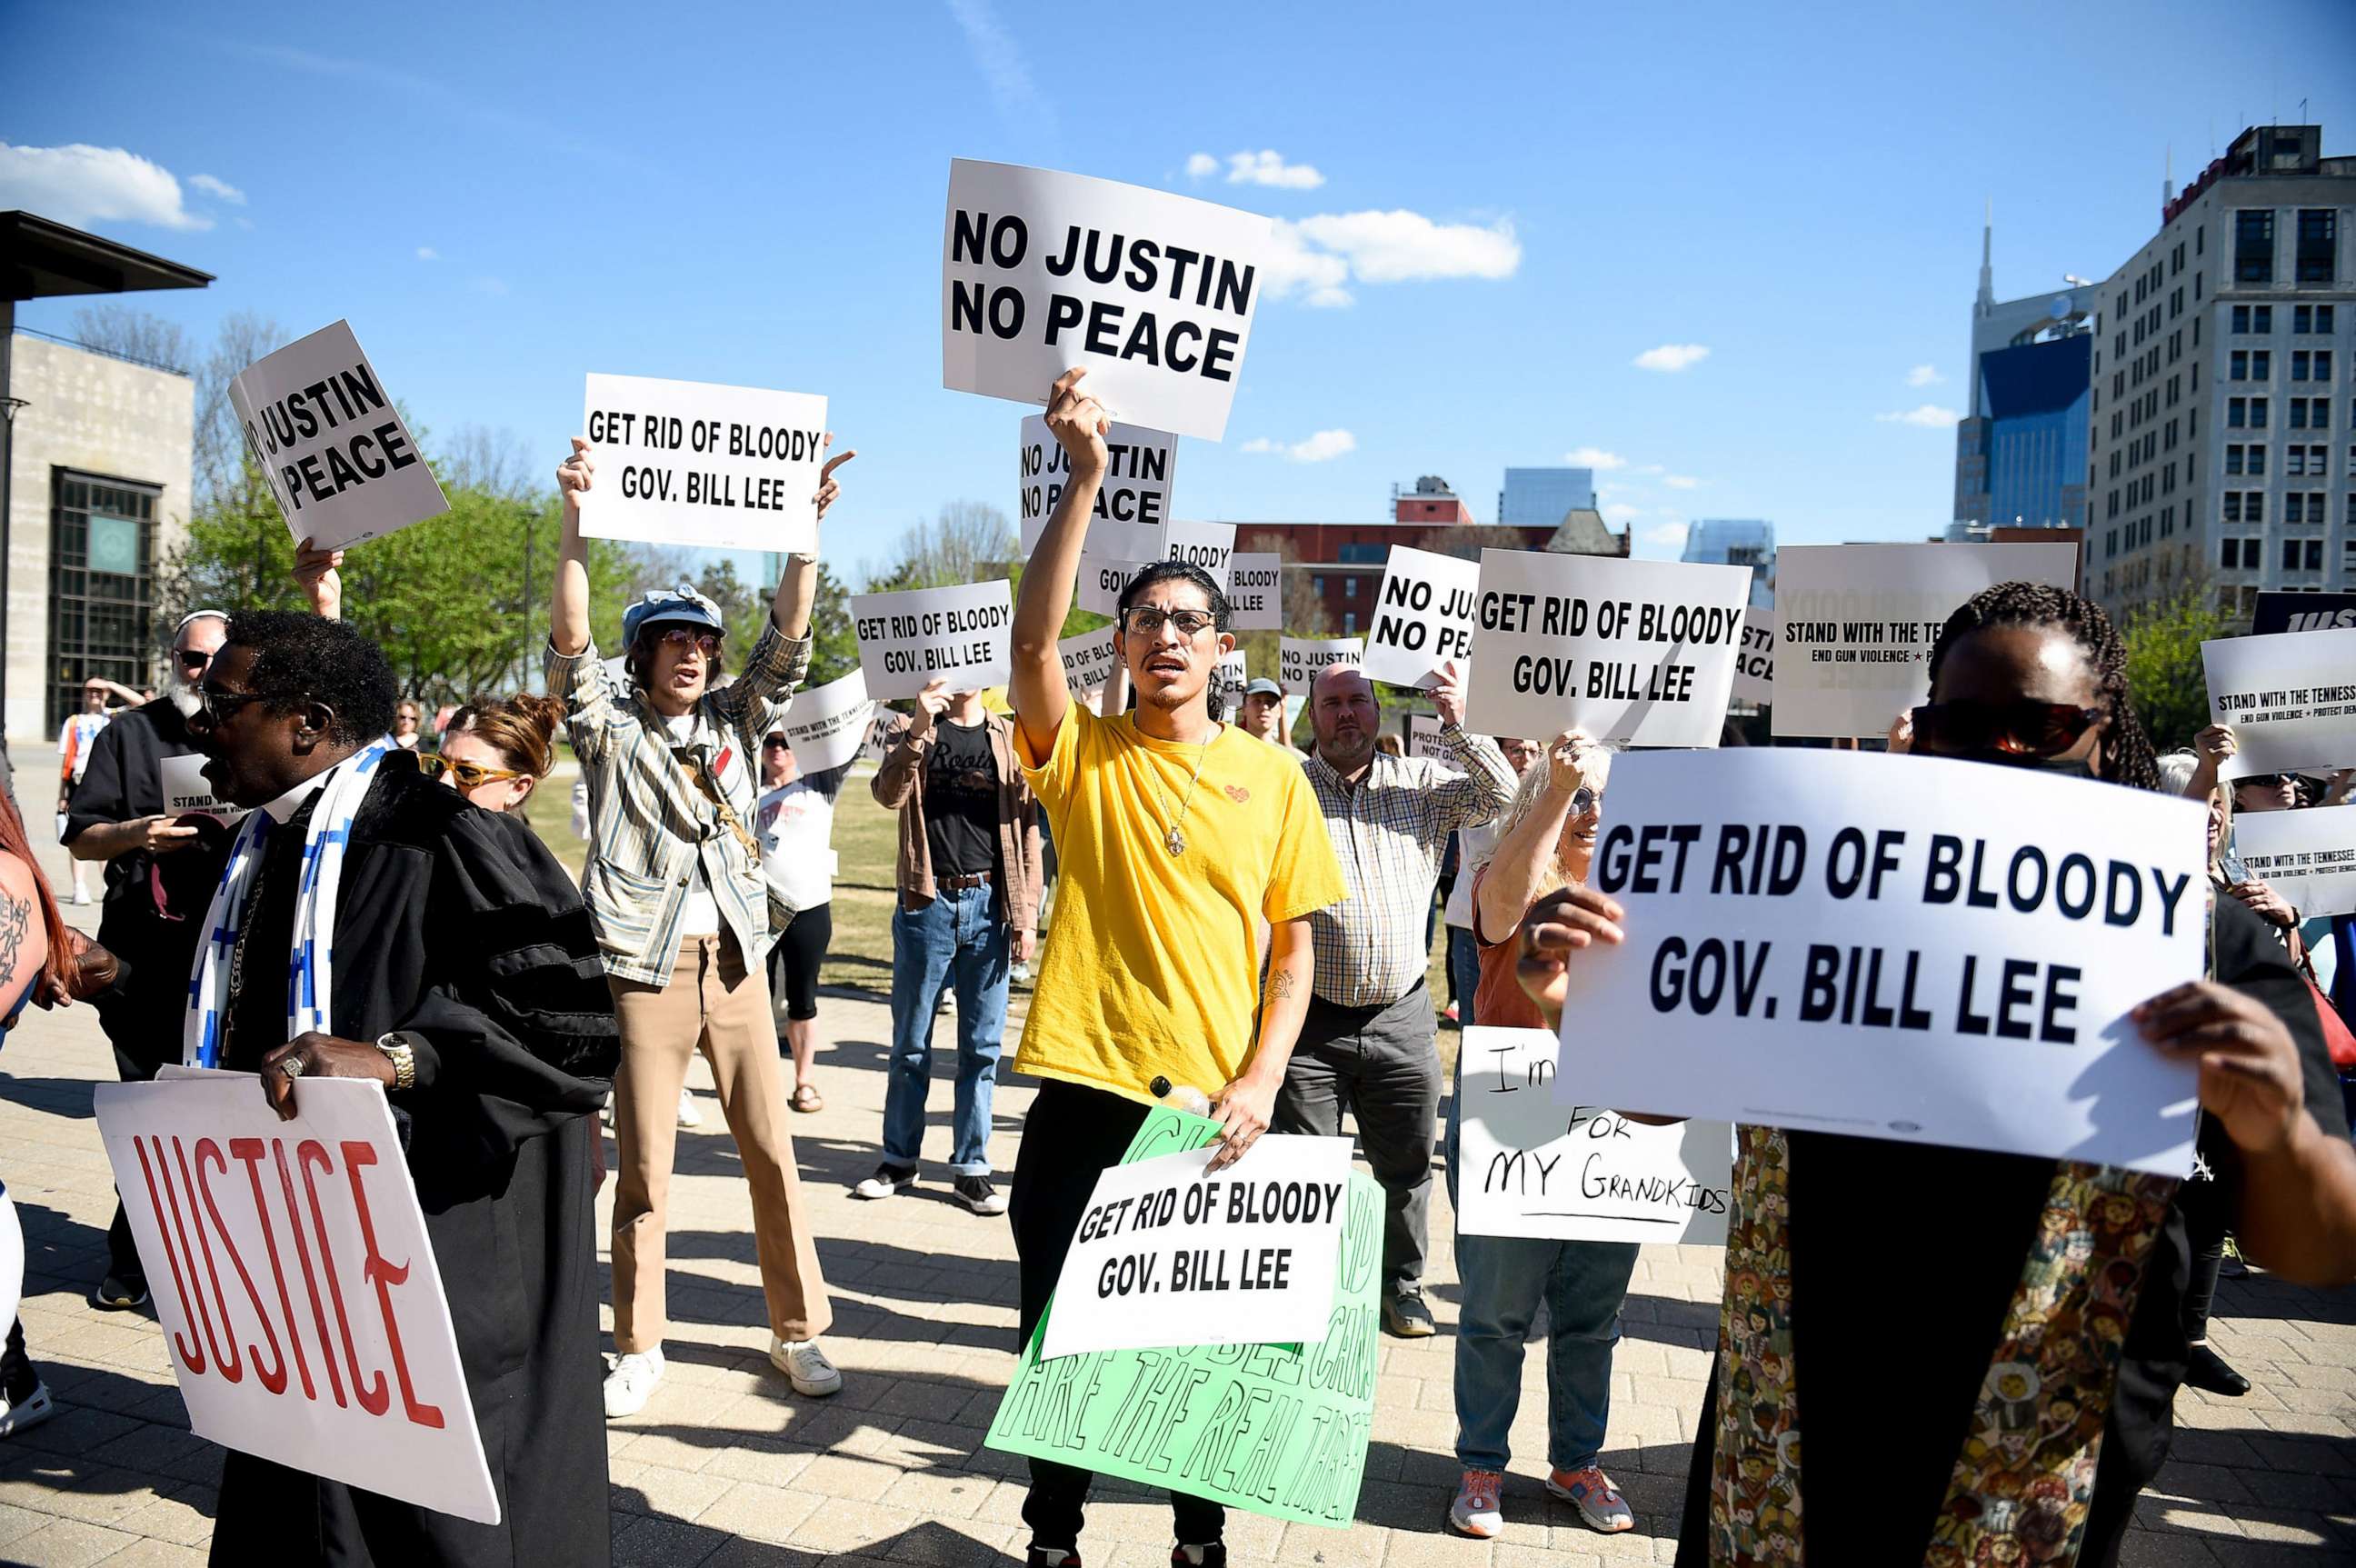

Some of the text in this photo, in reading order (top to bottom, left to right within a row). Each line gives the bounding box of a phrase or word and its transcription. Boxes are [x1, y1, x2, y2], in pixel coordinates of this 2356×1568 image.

[953, 209, 1255, 315] NO JUSTIN
[952, 279, 1239, 382] NO PEACE
[260, 363, 385, 454] JUSTIN
[589, 410, 821, 463] GET RID OF BLOODY
[281, 421, 417, 510] PEACE
[1022, 444, 1042, 478] NO
[622, 465, 784, 511] GOV. BILL LEE
[1023, 484, 1162, 524] NO PACE
[1170, 544, 1230, 569] BLOODY
[1100, 569, 1132, 593] GOV
[1234, 571, 1279, 587] BLOODY
[1385, 575, 1432, 611] NO
[1243, 595, 1263, 611] LEE
[1481, 591, 1742, 645] GET RID OF BLOODY
[857, 604, 1009, 641] GET RID OF BLOODY
[1376, 614, 1426, 651] NO
[1785, 622, 1837, 644] STAND
[1842, 623, 1883, 643] WITH
[1889, 623, 1918, 643] THE
[884, 641, 992, 674] GOV. BILL LEE
[1076, 650, 1090, 665] OF
[1092, 642, 1114, 660] BLO
[1282, 650, 1361, 665] NO JUSTIN
[1812, 650, 1909, 663] END GUN VIOLENCE
[1083, 668, 1108, 685] BILL
[1282, 669, 1302, 681] NO
[1513, 654, 1695, 702] GOV. BILL LEE
[2218, 684, 2356, 711] STAND WITH THE TENNESS
[2241, 714, 2253, 724] END
[2256, 712, 2270, 722] GUN
[2272, 709, 2303, 721] VIOLENCE
[2313, 706, 2342, 717] PROTECT
[1413, 731, 1450, 747] PROTEC
[1422, 744, 1441, 757] NOT
[173, 795, 212, 807] STAND
[2244, 849, 2355, 869] STAND WITH THE TENNESSEE
[1598, 824, 2191, 937] GET RID OF BLOODY
[1650, 936, 2081, 1044] GOV. BILL LEE
[1488, 1044, 1556, 1093] I'm
[1567, 1106, 1632, 1139] FOR
[1484, 1149, 1561, 1196] MY
[1079, 1181, 1343, 1243] GET RID OF BLOODY
[133, 1134, 445, 1429] JUSTICE
[1097, 1248, 1292, 1299] GOV. BILL LEE
[998, 1350, 1117, 1450] ARE
[1099, 1352, 1211, 1473] THE
[1180, 1380, 1303, 1504] REAL
